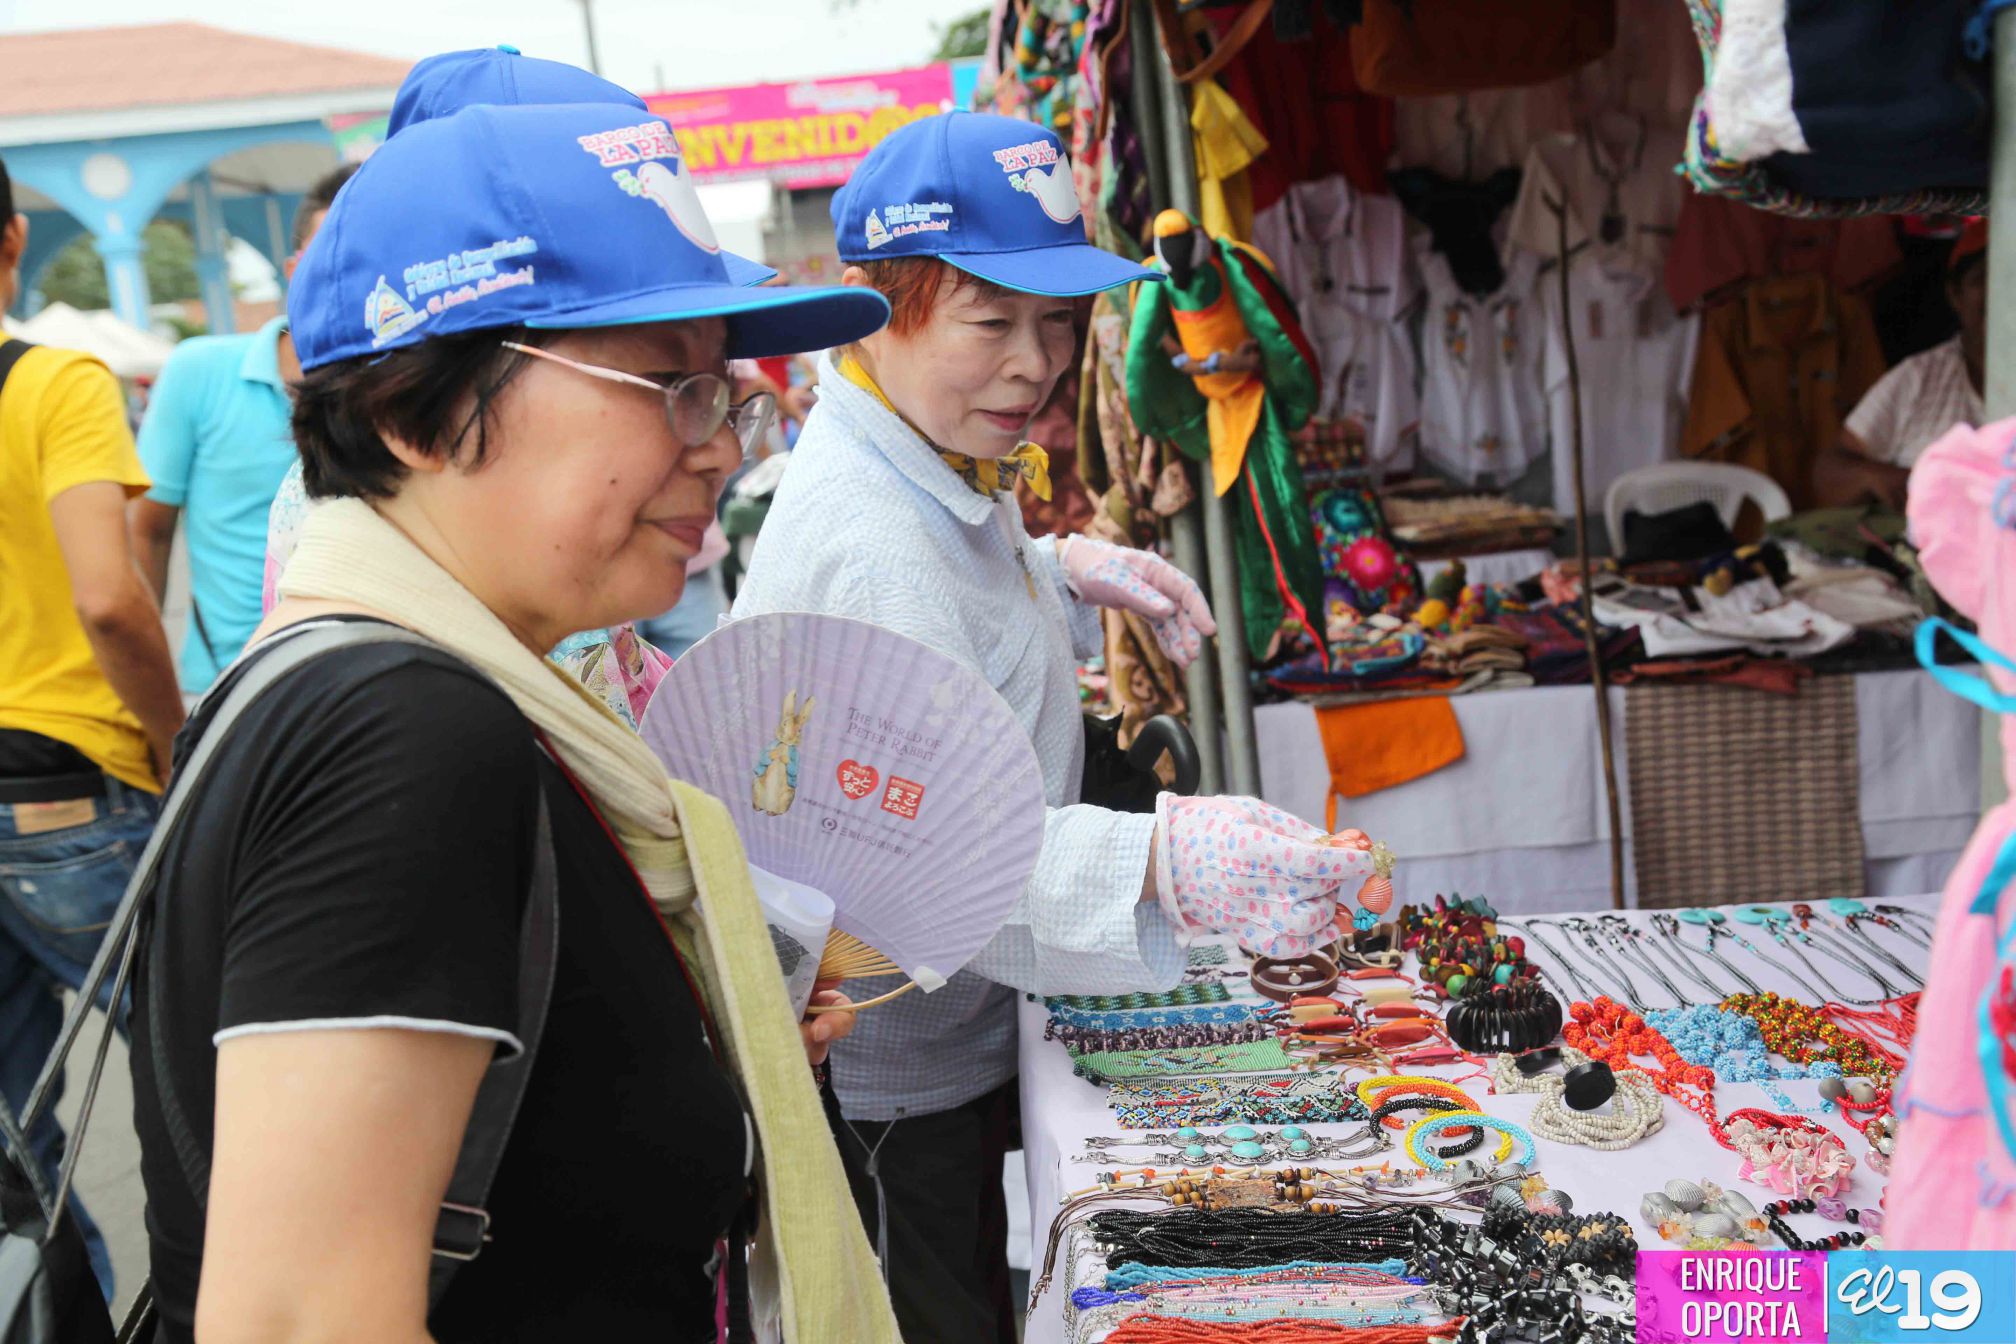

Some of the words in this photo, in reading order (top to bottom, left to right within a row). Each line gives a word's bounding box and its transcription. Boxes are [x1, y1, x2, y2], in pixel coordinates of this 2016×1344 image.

[579, 126, 642, 150] BARCO
[640, 121, 668, 139] DE
[599, 143, 638, 165] LA
[993, 144, 1032, 161] BARCO
[1033, 140, 1051, 153] DE
[1003, 155, 1027, 171] LA
[1028, 148, 1057, 166] PAZ
[848, 707, 872, 726] THE
[878, 717, 922, 743] WORLD
[925, 737, 943, 749] OF
[847, 722, 887, 745] PETER
[891, 737, 936, 762] RABBIT
[842, 769, 872, 789] ずっと
